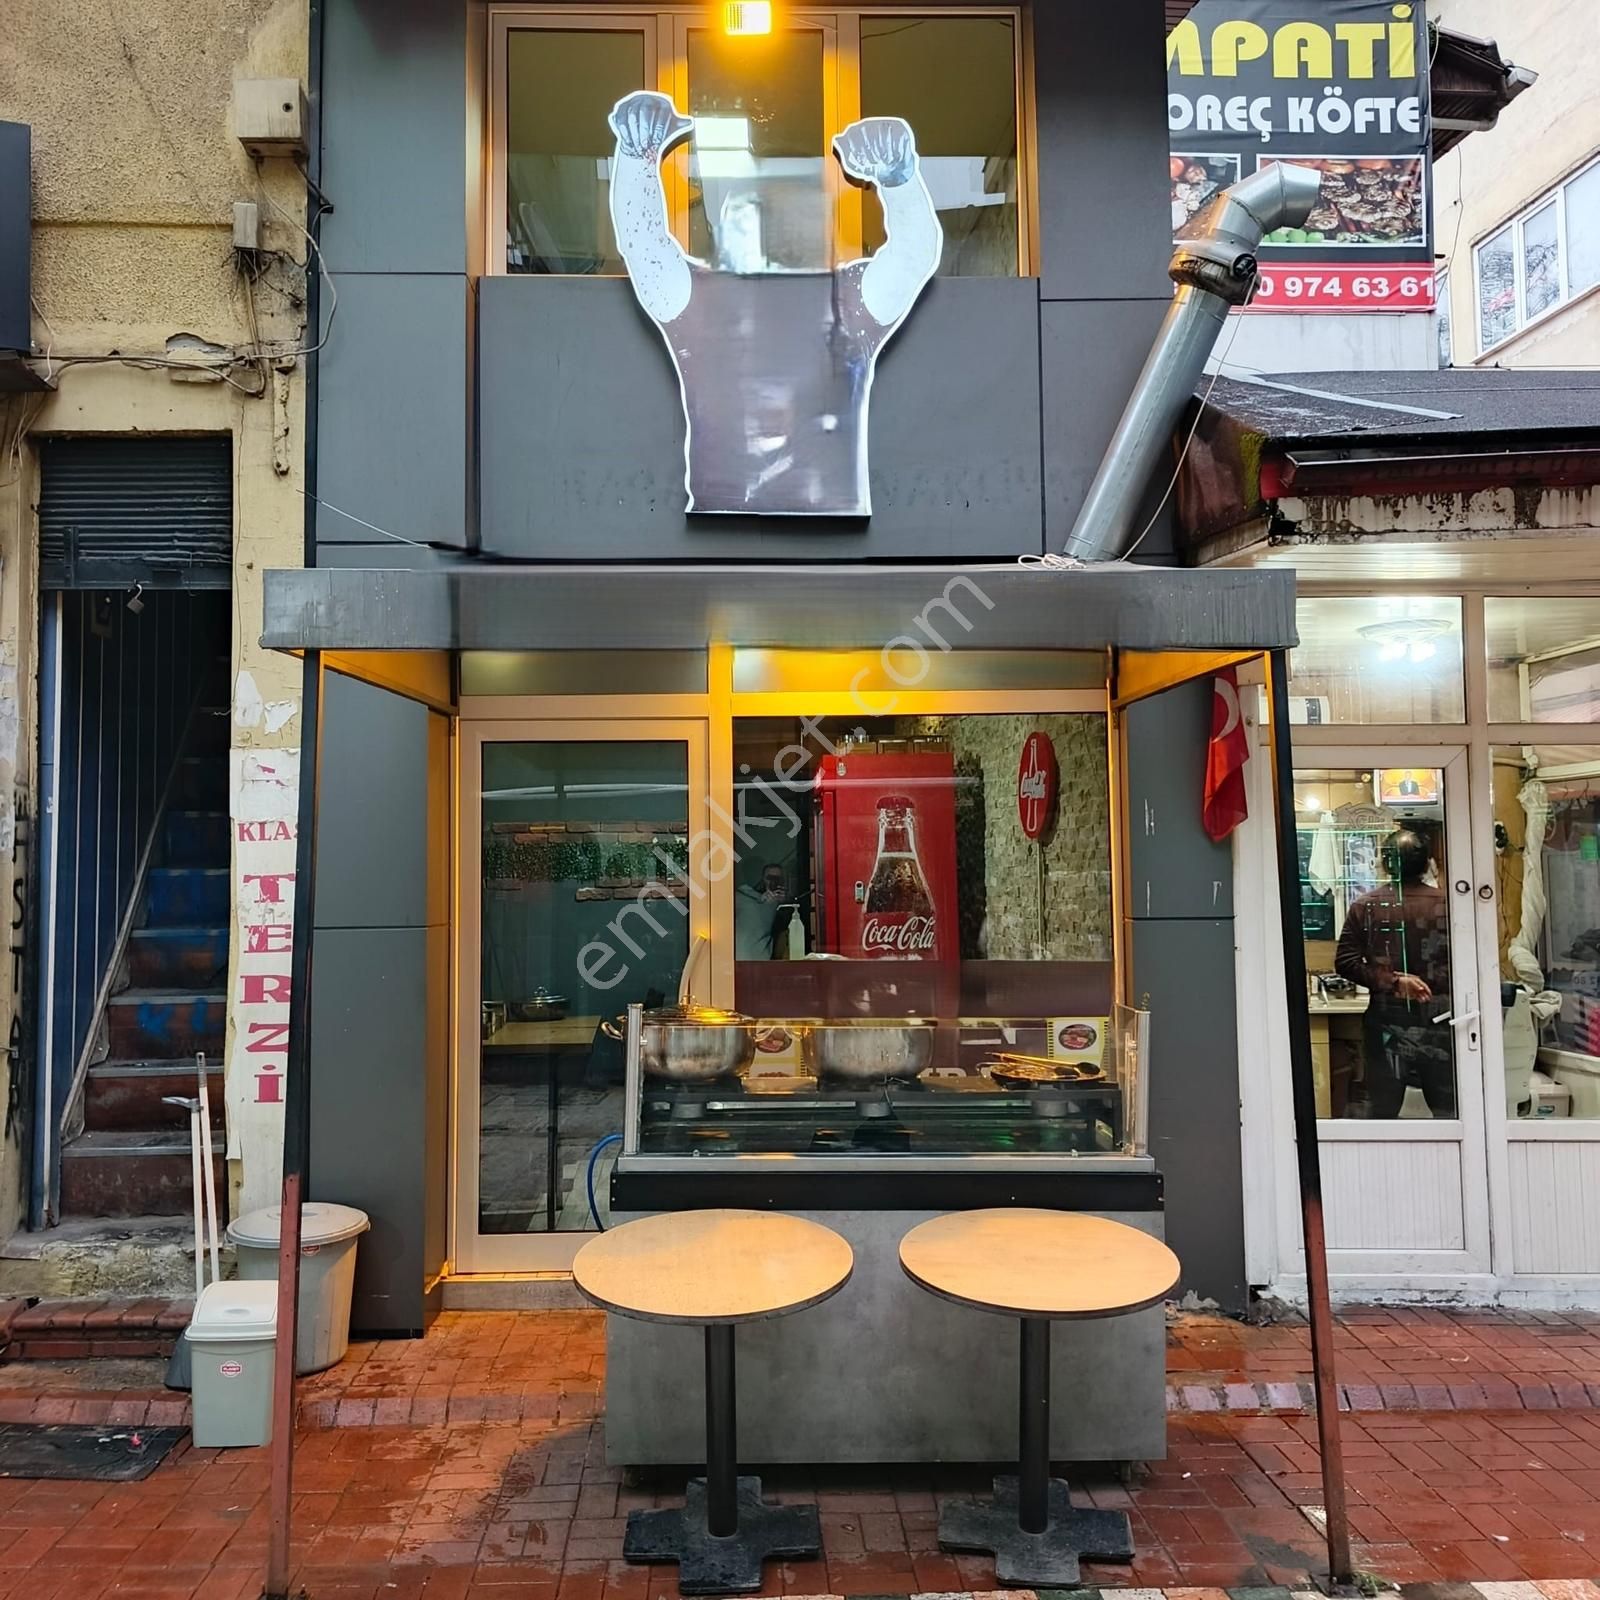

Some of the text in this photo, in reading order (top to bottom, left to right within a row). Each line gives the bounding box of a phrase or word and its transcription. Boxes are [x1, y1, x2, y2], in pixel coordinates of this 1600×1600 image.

[1288, 86, 1420, 134] KÖFTE
[1285, 276, 1343, 298] 974
[1352, 277, 1390, 298] 63
[1400, 277, 1434, 298] 61
[238, 820, 298, 842] KLA
[862, 915, 936, 952] Coca-Cola
